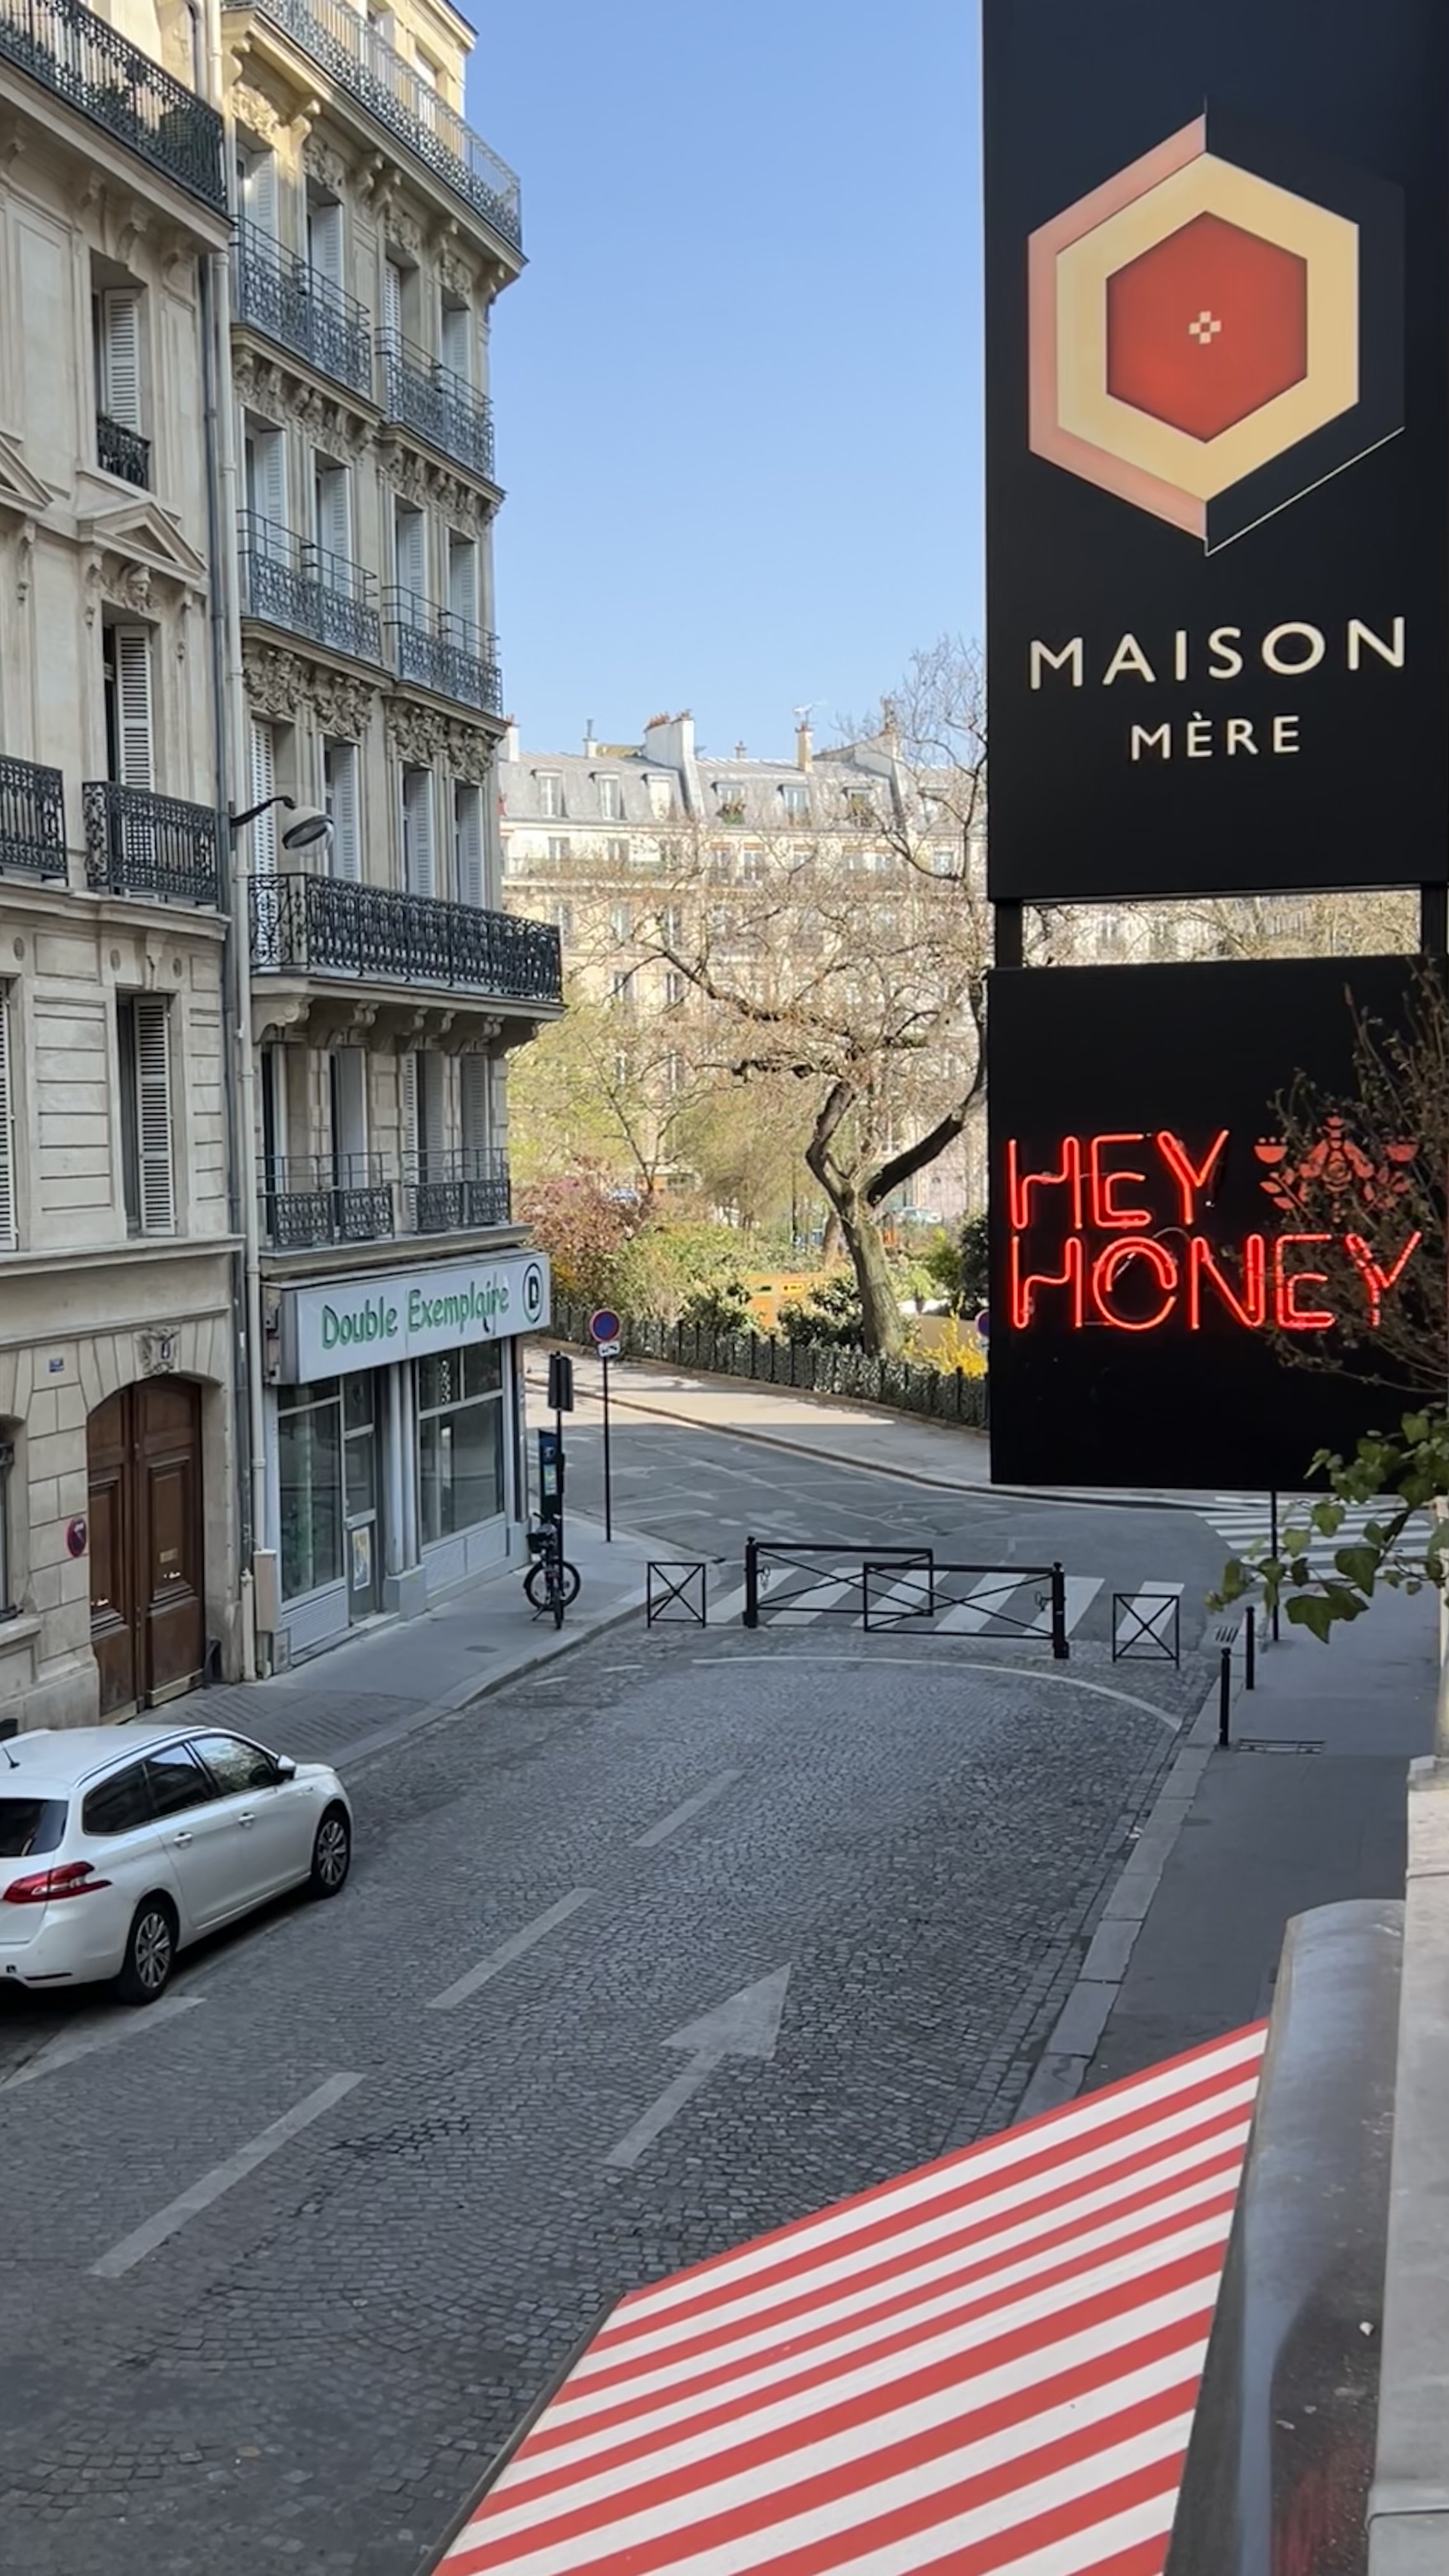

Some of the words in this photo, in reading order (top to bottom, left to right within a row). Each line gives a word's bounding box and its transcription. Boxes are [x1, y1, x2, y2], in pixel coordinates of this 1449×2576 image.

[1030, 616, 1406, 691] MAISON
[1131, 711, 1301, 761] MÈRE
[1008, 1129, 1230, 1229] HEY
[321, 1296, 399, 1349] Double
[407, 1280, 509, 1334] Exemplaire
[1011, 1230, 1422, 1330] HONEY
